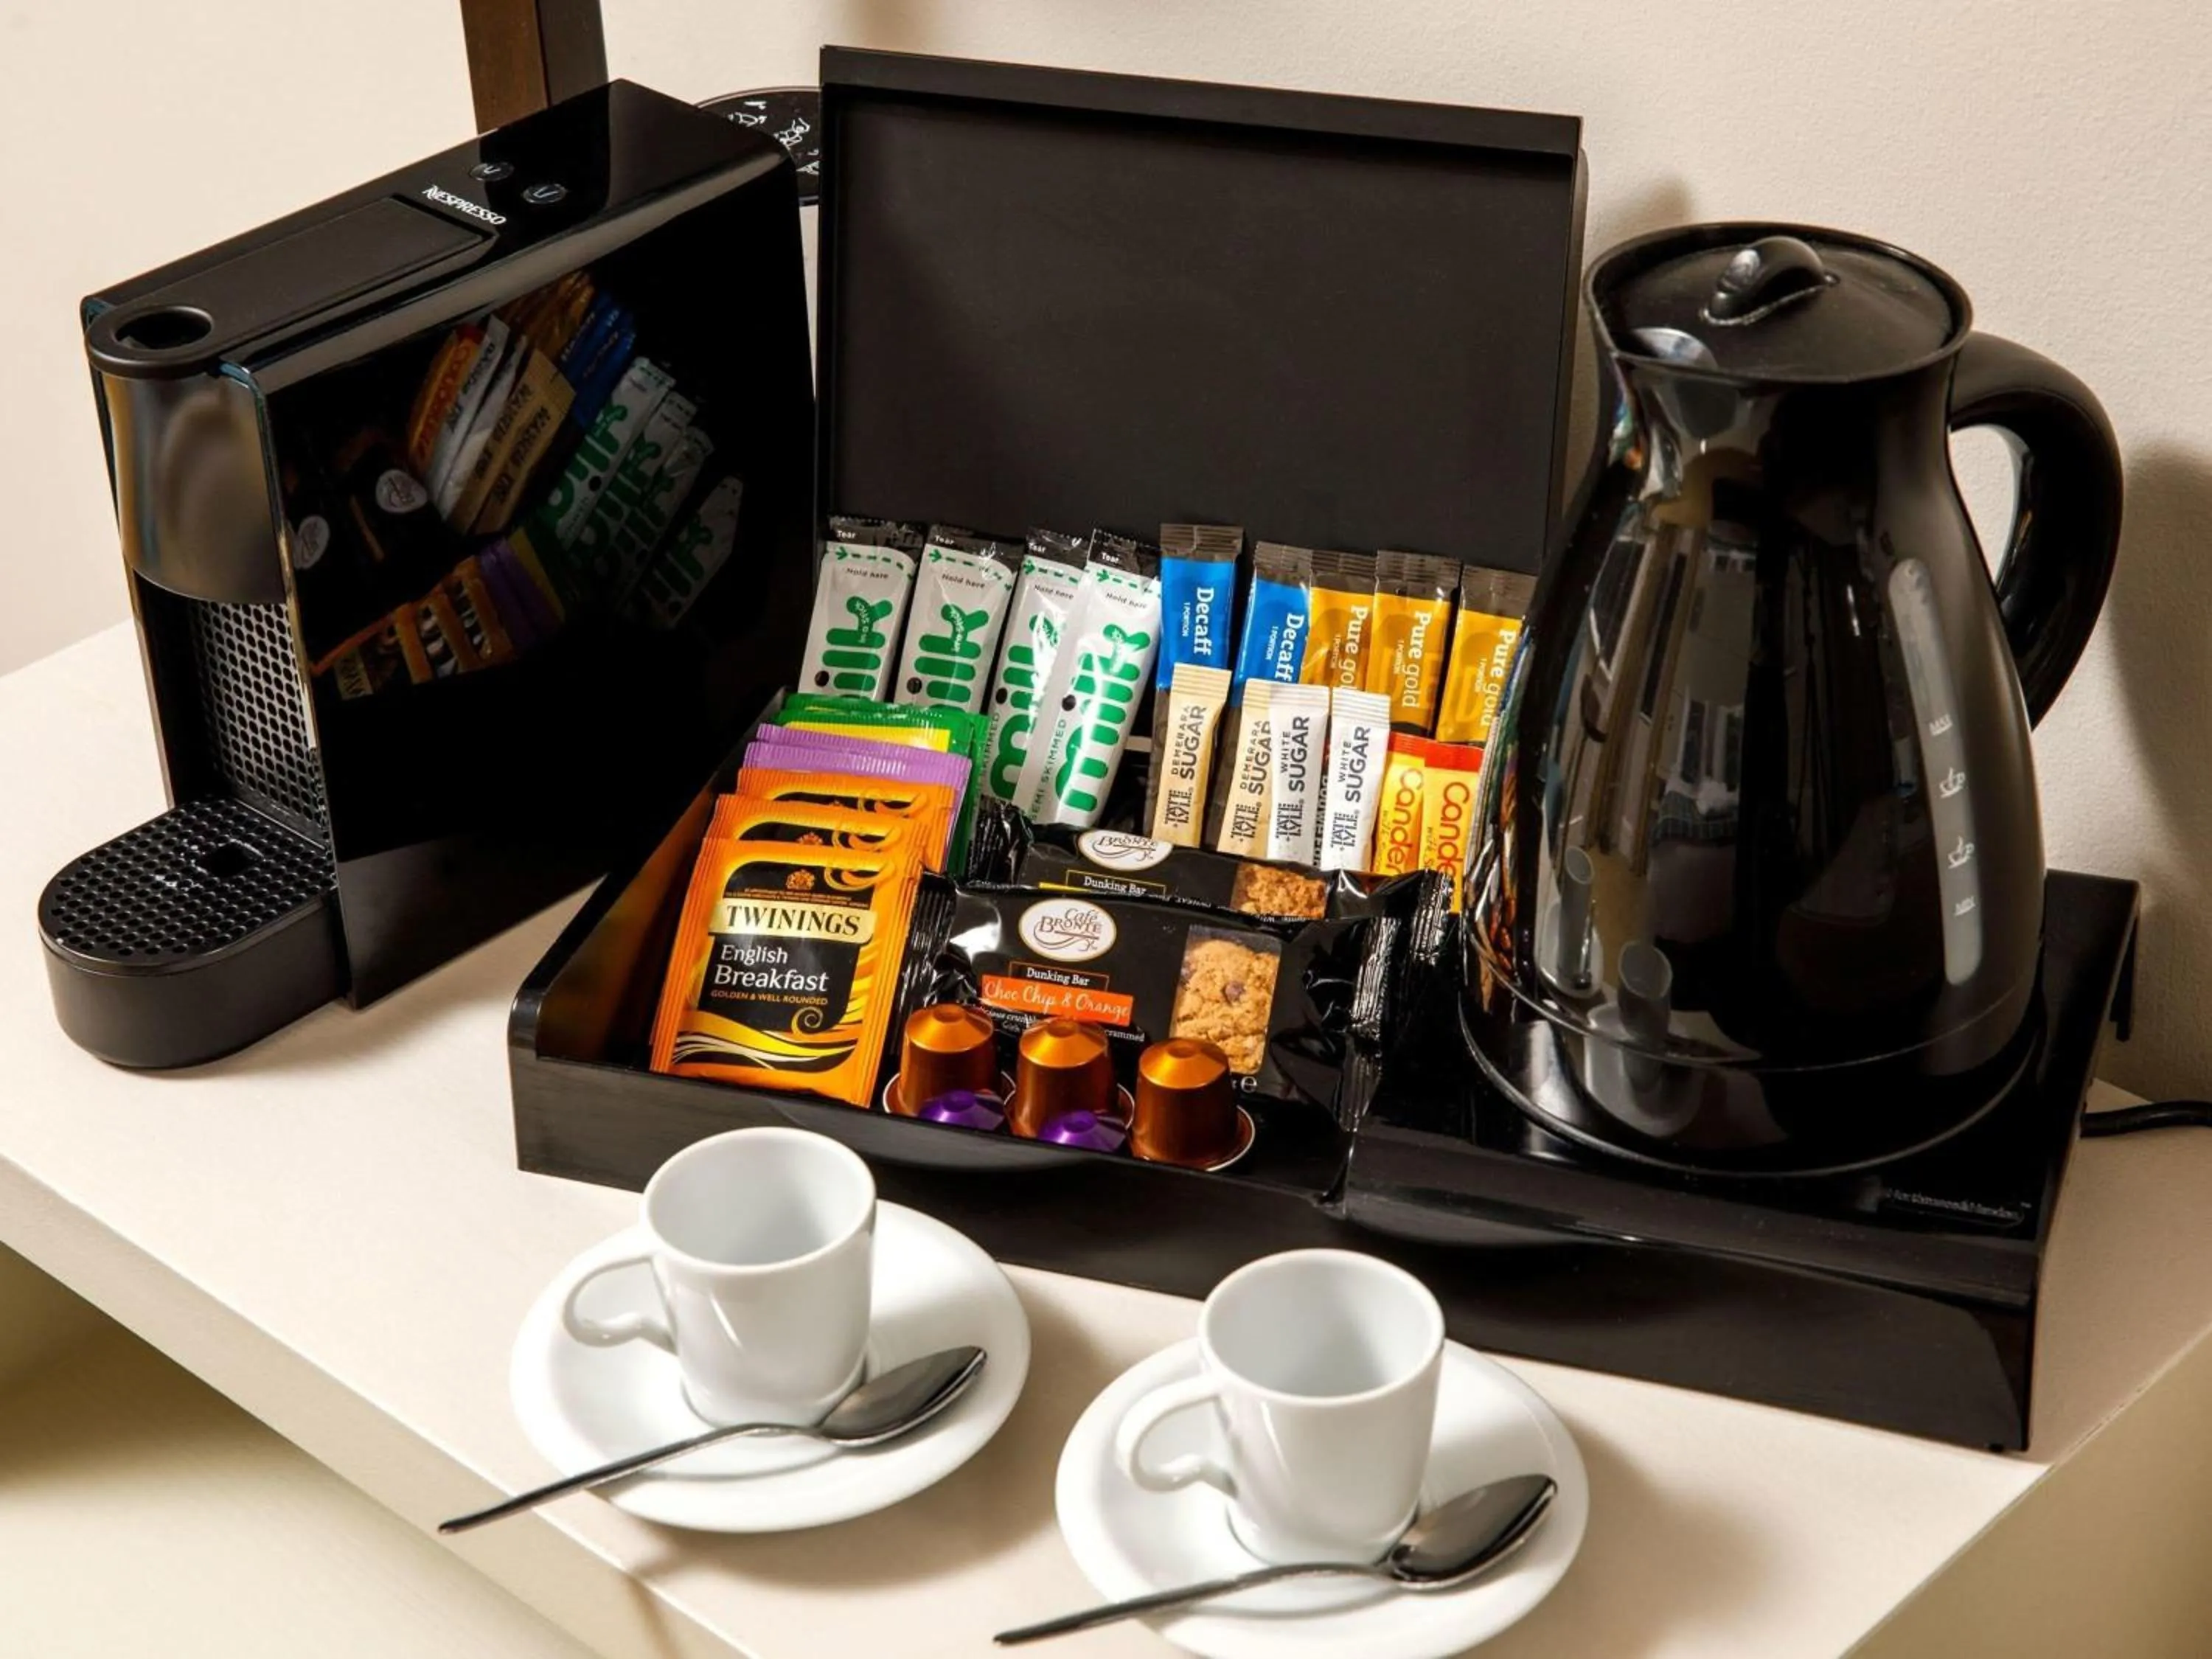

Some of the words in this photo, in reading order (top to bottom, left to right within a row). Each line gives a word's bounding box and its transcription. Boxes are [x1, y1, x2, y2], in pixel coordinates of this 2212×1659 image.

[421, 184, 507, 225] NESPRESSO
[837, 529, 856, 539] Tear
[935, 535, 954, 545] Tear
[1028, 541, 1046, 553] Tear
[1102, 552, 1119, 563] Tear
[1182, 606, 1191, 637] PORTION
[1193, 587, 1214, 655] Decaff
[1345, 605, 1368, 655] Pure
[1408, 612, 1432, 659] Pure
[814, 596, 893, 700] ilk
[907, 603, 989, 712] ilk
[1275, 613, 1304, 683] Decaff
[1490, 630, 1517, 678] Pure
[1339, 658, 1357, 689] gol
[1402, 664, 1422, 708] gold
[1043, 719, 1068, 785] SKIMMED
[1180, 706, 1207, 781] SUGAR
[1239, 720, 1262, 789] DEMERARA
[1281, 731, 1291, 773] WHITE
[1288, 716, 1310, 793] SUGAR
[1338, 740, 1352, 783] WHITE
[1345, 726, 1371, 803] SUGAR
[1165, 789, 1180, 824] TATE
[1231, 804, 1245, 838] TATE
[1276, 802, 1290, 839] TATE
[1385, 768, 1424, 875] Cander
[1330, 811, 1346, 848] TATE
[1437, 782, 1470, 876] Cande
[1084, 876, 1127, 893] Dunking
[1129, 883, 1147, 896] Bar
[727, 905, 860, 936] TWININGS
[1065, 908, 1099, 927] Café
[721, 944, 788, 966] English
[714, 964, 829, 992] Breakfast
[1026, 967, 1070, 985] Dunking
[1071, 974, 1090, 986] Bar
[711, 990, 748, 1000] GOLDEN
[758, 993, 780, 1003] WELL
[782, 995, 828, 1005] ROUNDED
[984, 980, 1018, 999] Choc
[1023, 984, 1057, 1014] Chip
[1062, 993, 1071, 1007] &
[1076, 994, 1130, 1020] Orange
